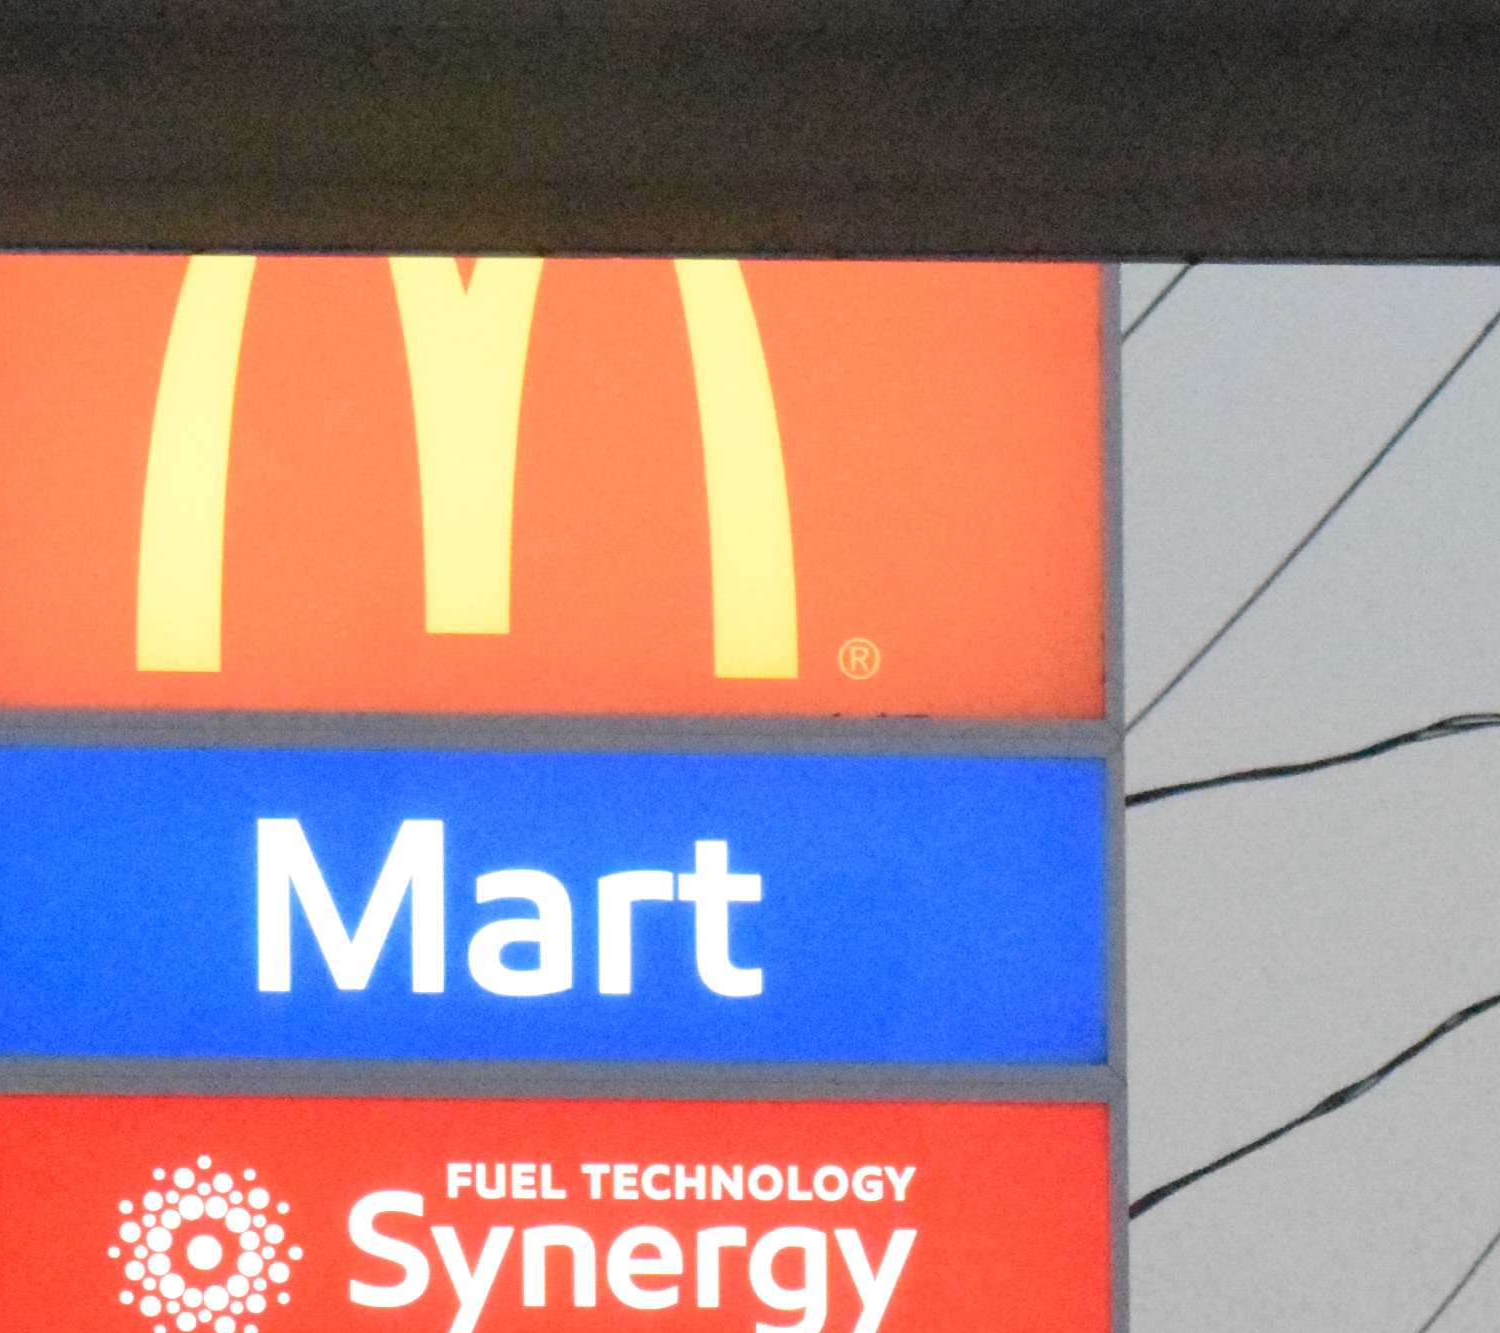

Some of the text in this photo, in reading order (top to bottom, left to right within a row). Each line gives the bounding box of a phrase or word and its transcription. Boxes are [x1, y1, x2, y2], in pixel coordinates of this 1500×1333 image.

[256, 817, 764, 998] Mart
[446, 1161, 918, 1203] FUEL TECHNOLOGY
